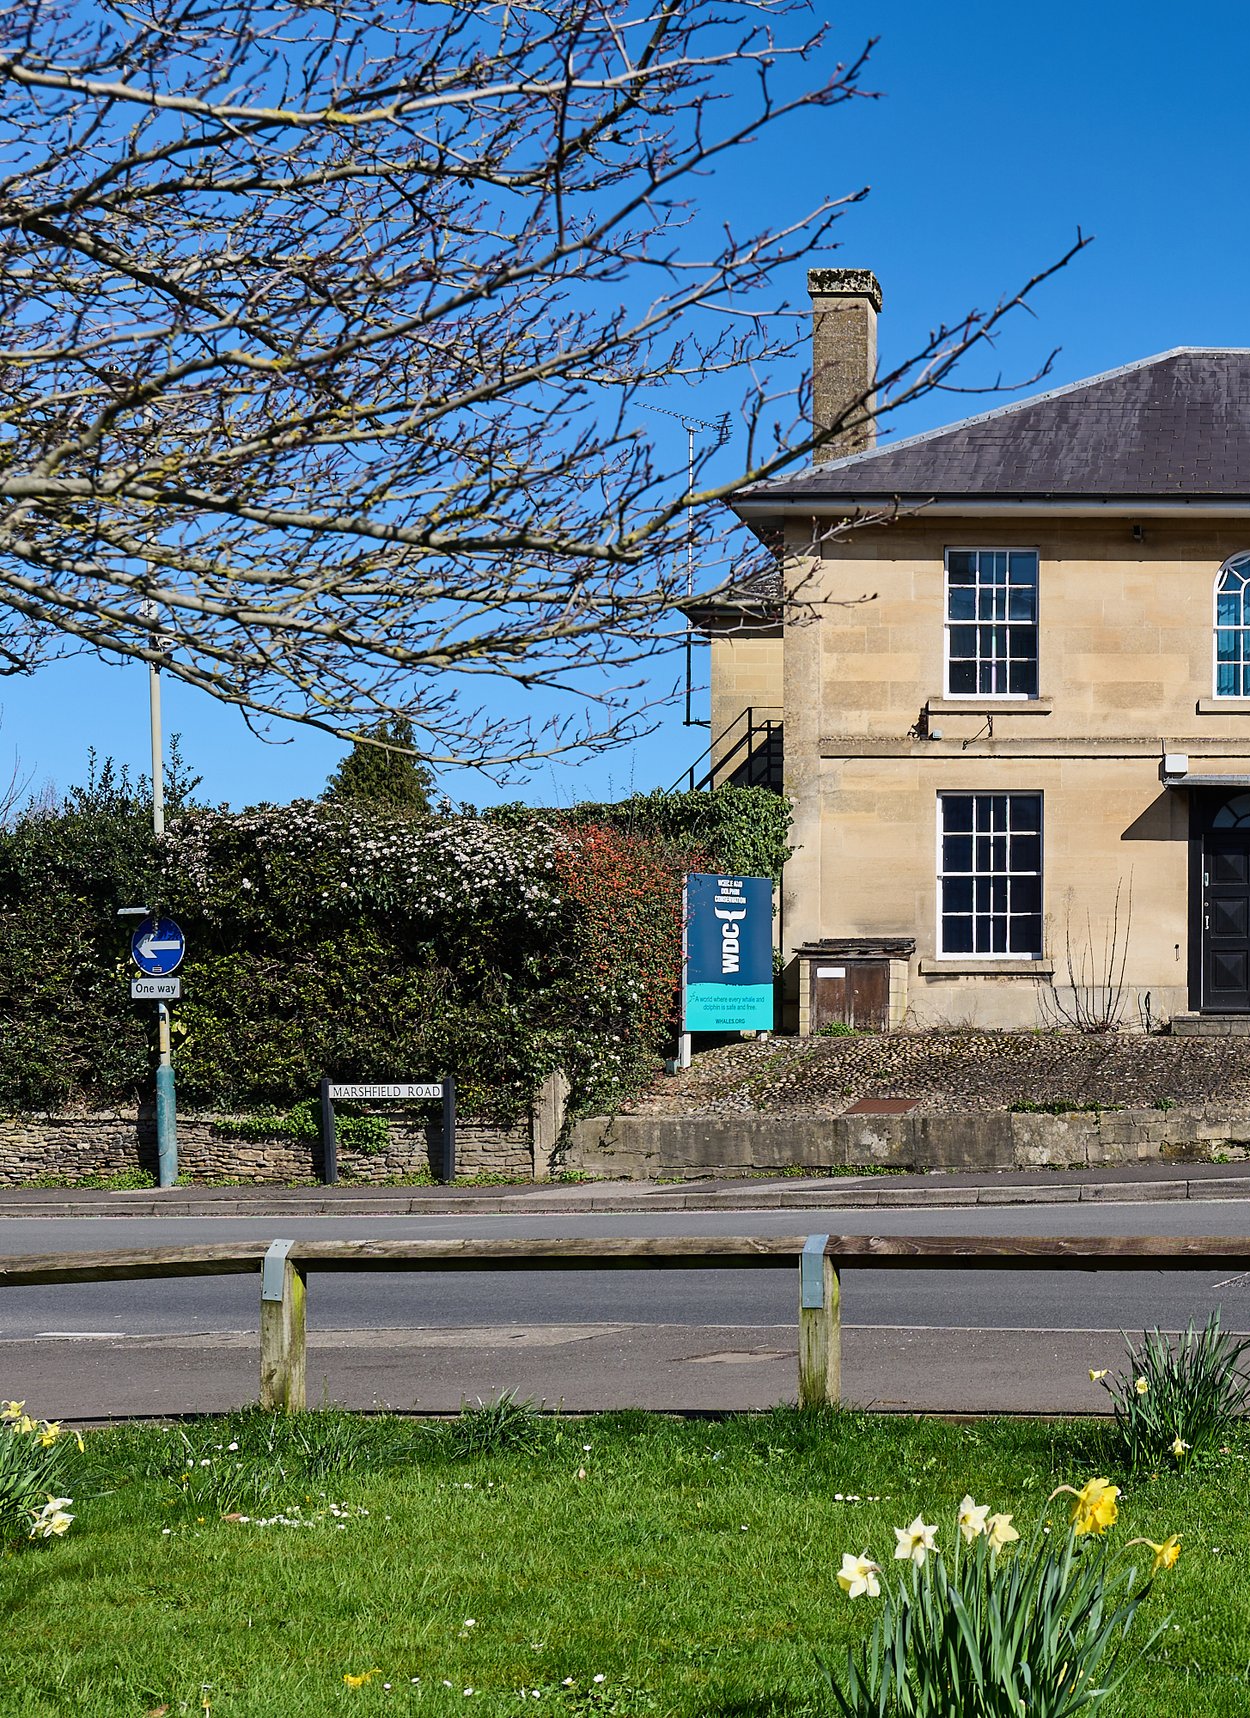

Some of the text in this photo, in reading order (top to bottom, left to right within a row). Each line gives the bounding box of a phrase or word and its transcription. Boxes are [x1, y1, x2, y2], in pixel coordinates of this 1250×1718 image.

[722, 923, 740, 974] WDC
[135, 983, 176, 994] One way
[333, 1086, 441, 1097] MARSHFIELD ROAD
